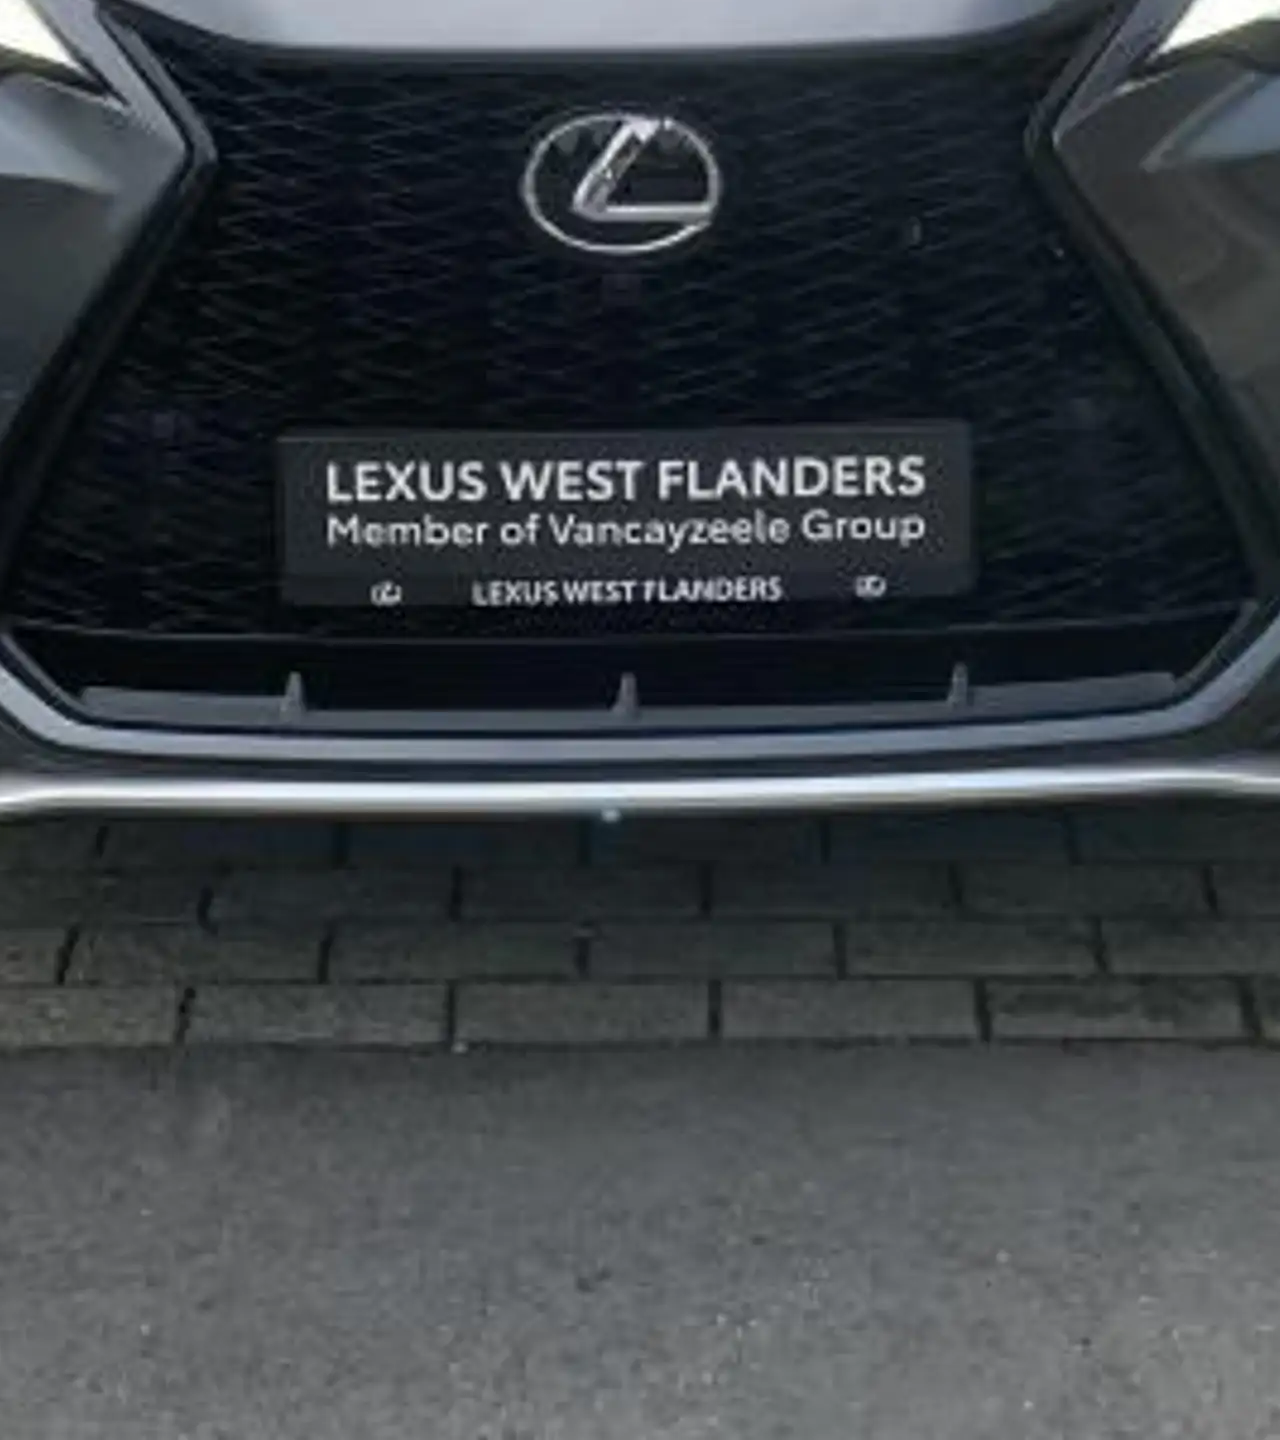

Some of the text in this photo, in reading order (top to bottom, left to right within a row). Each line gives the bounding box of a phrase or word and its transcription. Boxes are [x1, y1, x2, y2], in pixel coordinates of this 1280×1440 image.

[326, 456, 926, 502] LEXUS WEST FLANDERS
[326, 509, 925, 553] Member of Vancayzeele Group
[472, 575, 783, 606] LEXUS WEST FLANDERS
